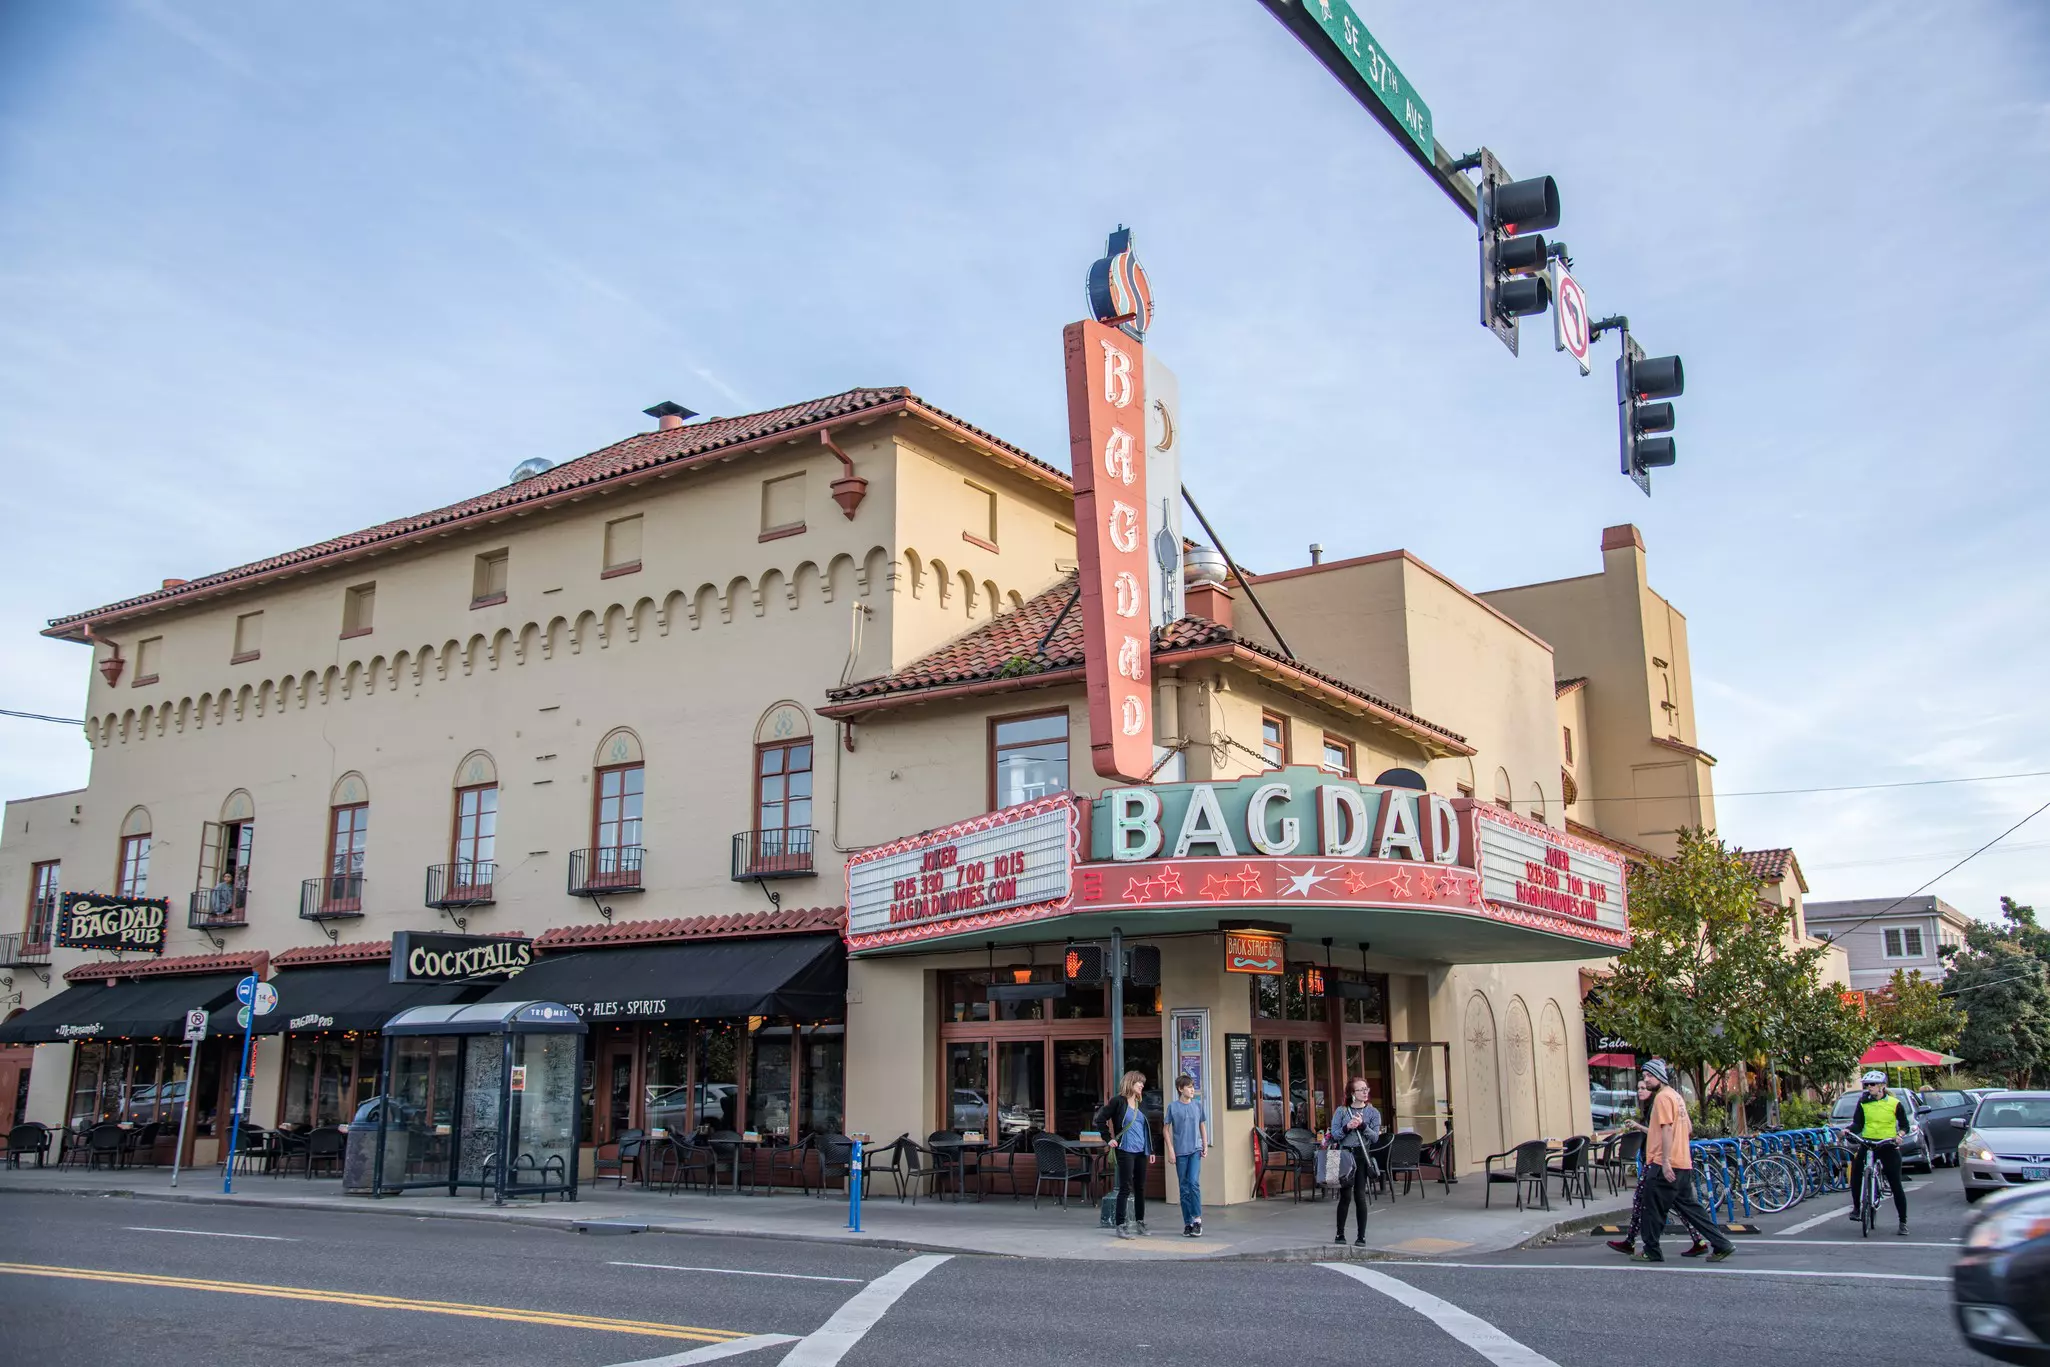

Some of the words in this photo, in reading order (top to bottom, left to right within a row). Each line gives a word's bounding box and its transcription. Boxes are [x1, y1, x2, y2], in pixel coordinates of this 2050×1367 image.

[1344, 15, 1360, 58] SE
[1368, 44, 1398, 94] 37TH
[1405, 98, 1425, 142] AVE
[1100, 338, 1146, 736] BAGDAD
[1111, 783, 1461, 865] BAGDAD
[920, 845, 957, 873] JOKER
[893, 877, 916, 901] 1215
[920, 871, 944, 895] 330
[956, 861, 985, 887] 700
[994, 851, 1024, 878] 1015
[1566, 873, 1583, 898] 700
[889, 877, 1017, 924] BAGDADMOVIES.COM
[69, 906, 164, 939] BAGDAD
[120, 927, 161, 944] PUB
[409, 942, 531, 976] COCKTAILS
[1228, 938, 1247, 957] BACK
[1248, 940, 1268, 957] STAGE
[1269, 941, 1282, 958] BAR
[290, 1014, 319, 1029] BAGDAD
[318, 1016, 334, 1027] PUB
[531, 1008, 544, 1016] TRI
[553, 1009, 568, 1017] MET
[593, 1002, 618, 1016] ALES
[626, 999, 666, 1015] SPIRITS
